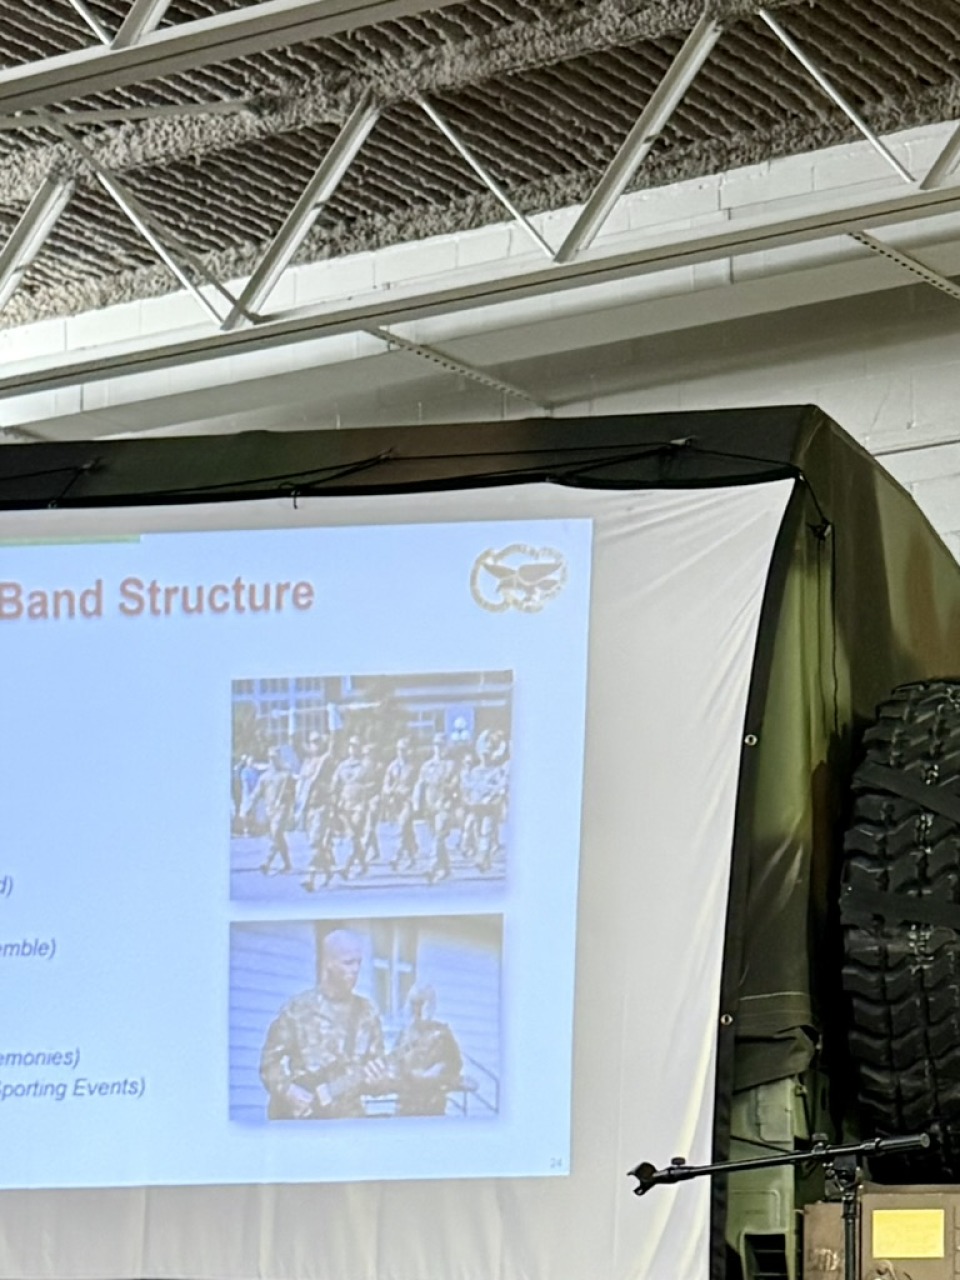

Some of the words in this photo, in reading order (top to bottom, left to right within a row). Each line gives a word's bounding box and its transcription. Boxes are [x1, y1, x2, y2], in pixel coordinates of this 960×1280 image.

[0, 578, 103, 620] Band
[118, 576, 316, 617] Structure
[0, 937, 56, 961] mble)
[0, 1081, 67, 1101] porting
[73, 1077, 145, 1099] Events)
